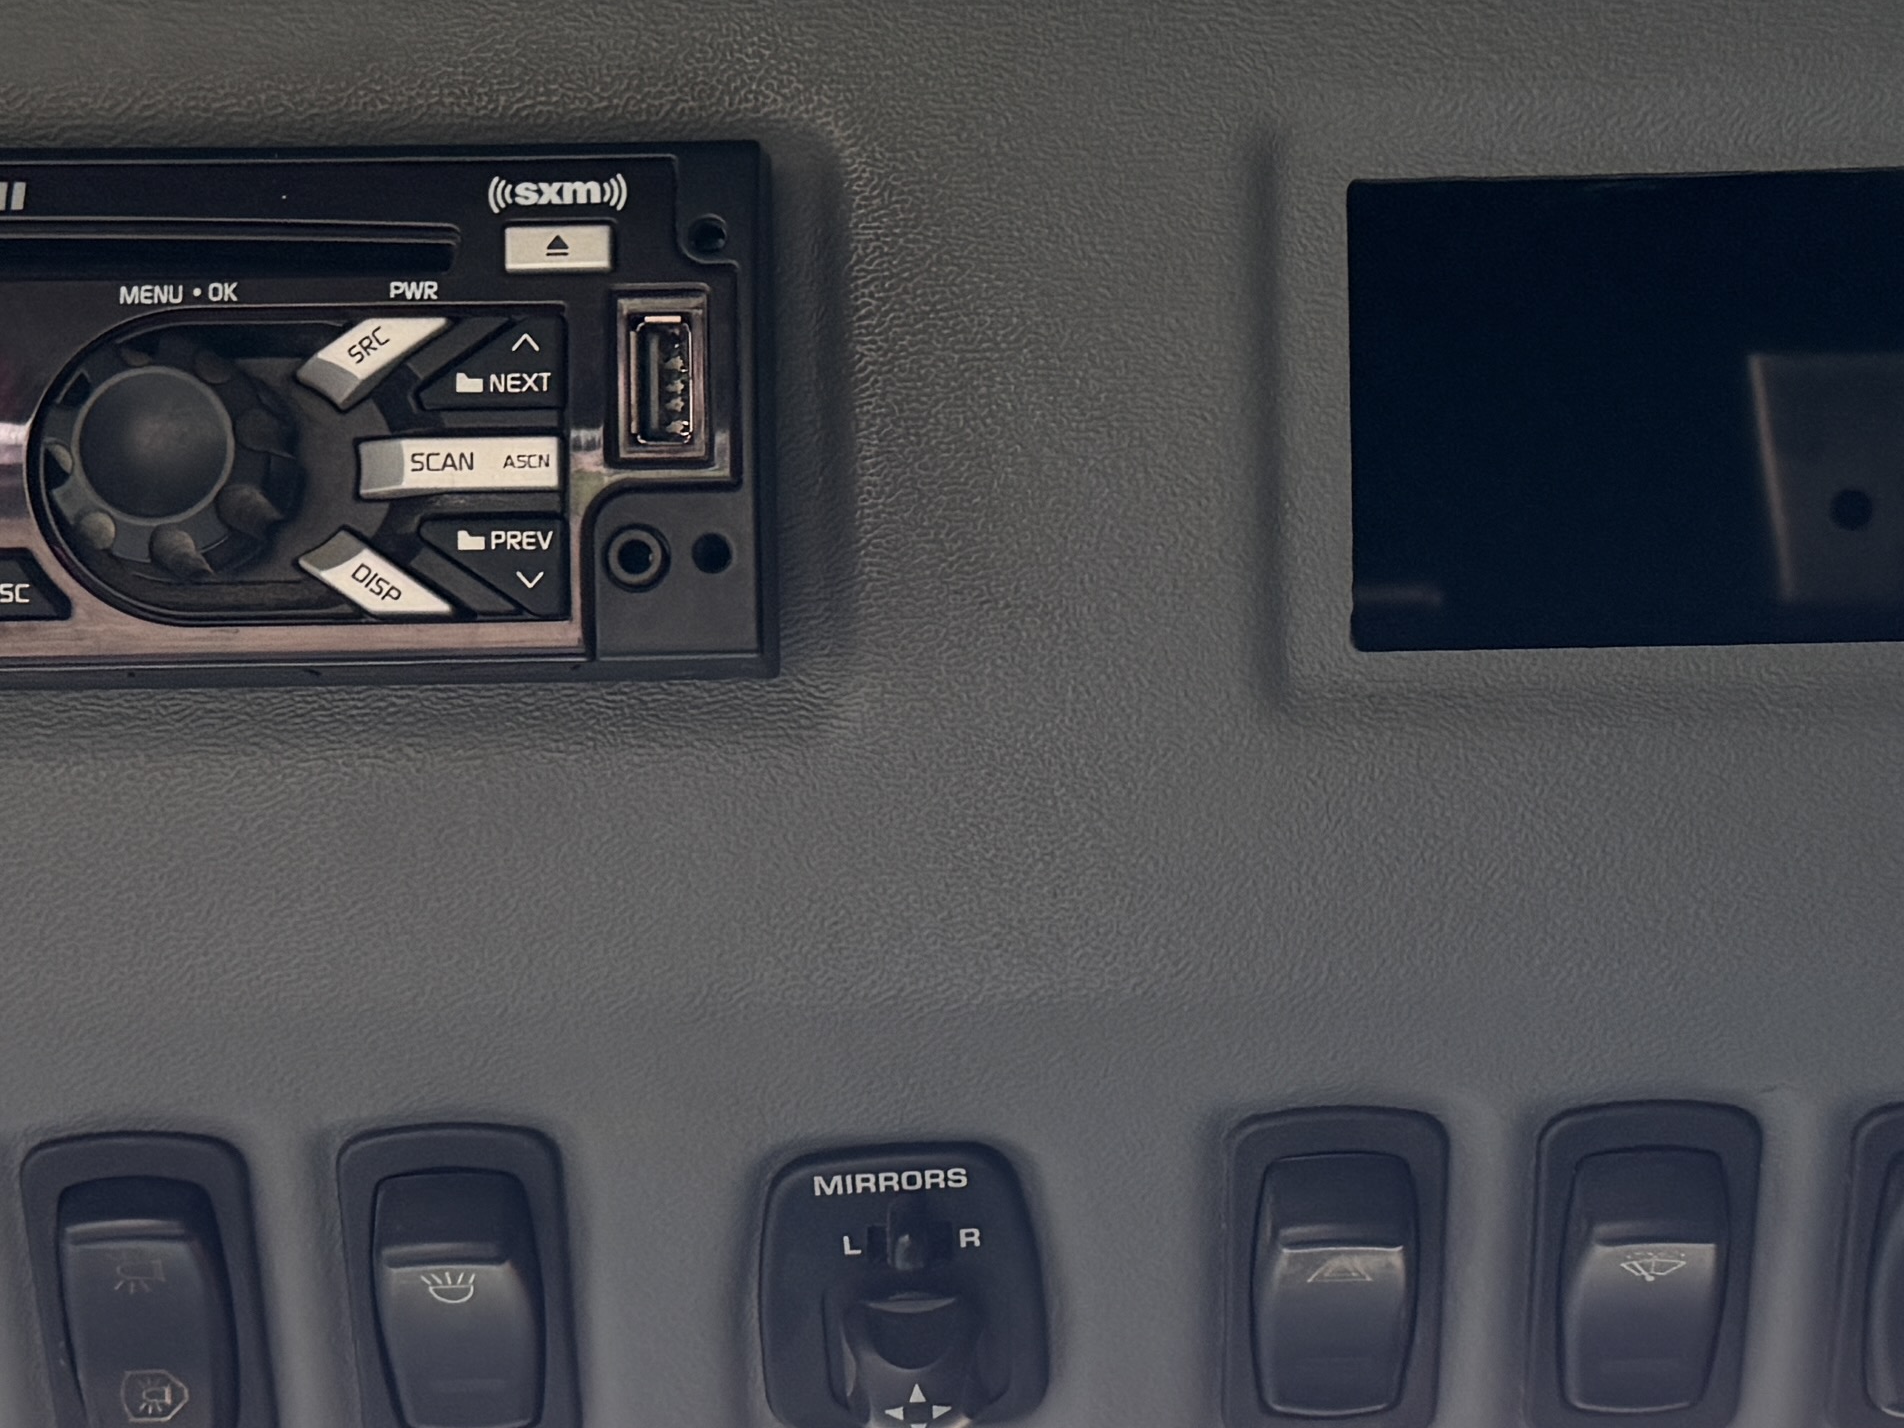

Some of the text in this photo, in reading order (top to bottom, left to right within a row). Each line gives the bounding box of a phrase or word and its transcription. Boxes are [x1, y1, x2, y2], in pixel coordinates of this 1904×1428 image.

[119, 282, 238, 305] MENU OK
[389, 281, 438, 300] PWR
[348, 326, 390, 364] SRC
[489, 372, 552, 393] NEXT
[410, 451, 550, 472] SCAN ASCN
[490, 530, 554, 550] PREV
[351, 562, 402, 601] DISP
[813, 1167, 968, 1197] MIRRORS
[842, 1235, 862, 1256] L
[959, 1227, 981, 1248] R
